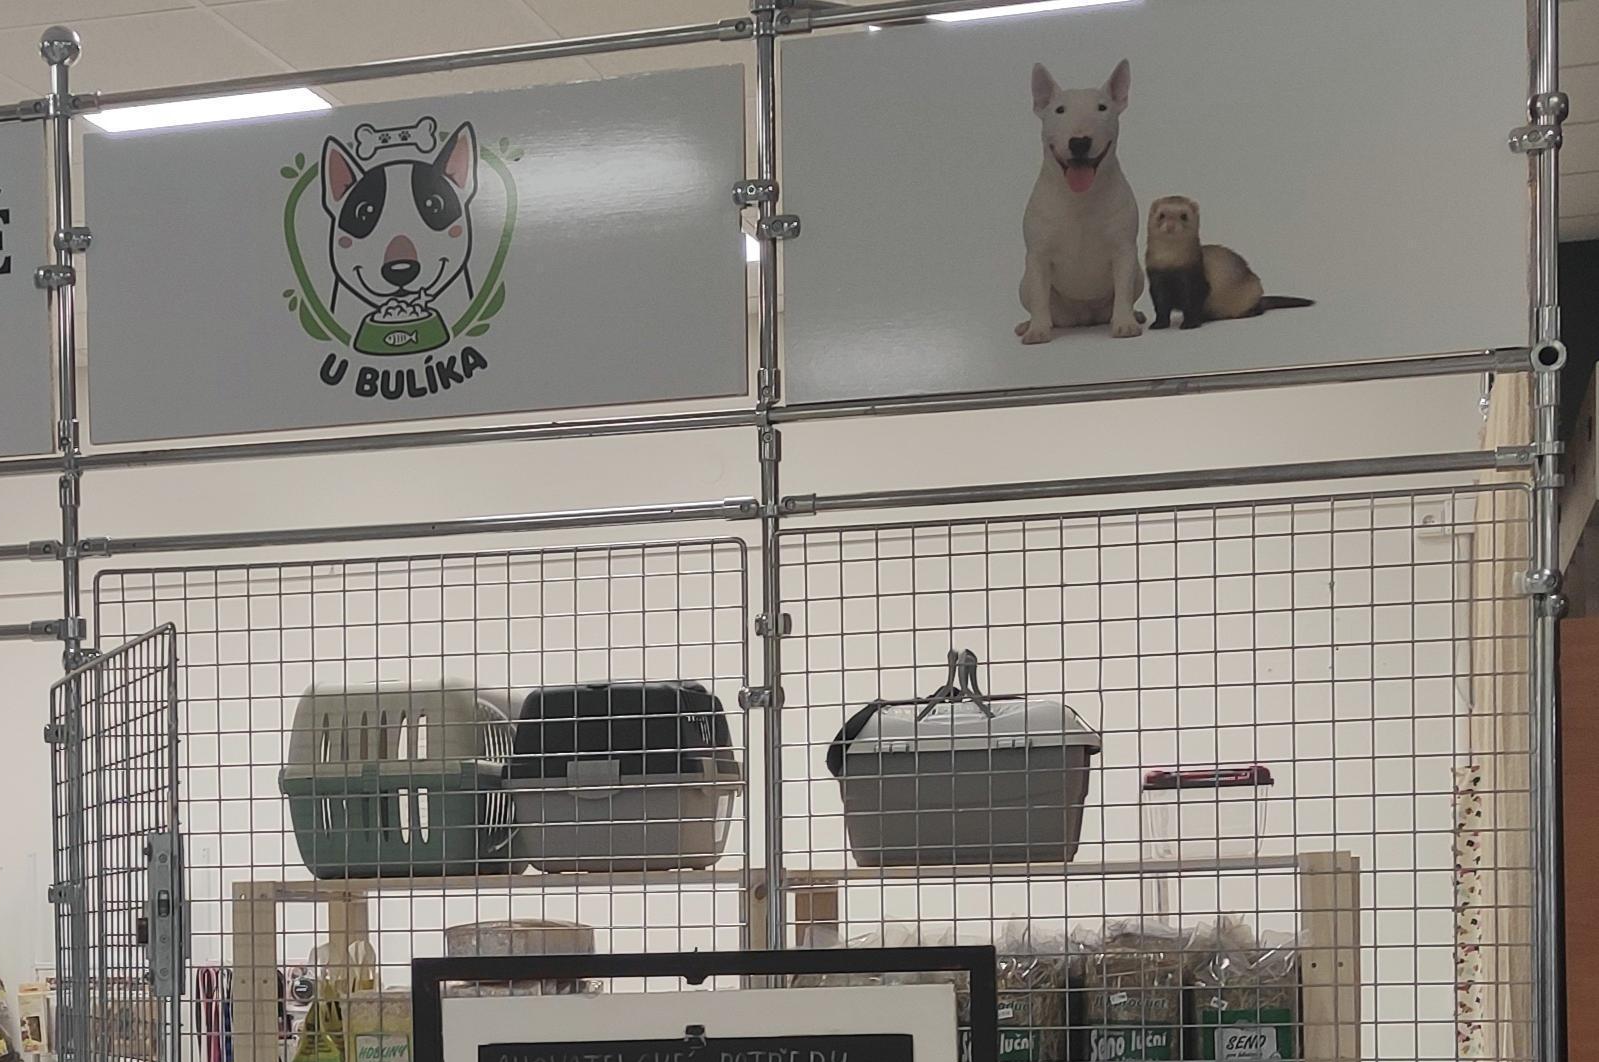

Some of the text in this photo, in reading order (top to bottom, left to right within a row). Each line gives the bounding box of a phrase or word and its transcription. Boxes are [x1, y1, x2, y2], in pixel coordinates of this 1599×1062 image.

[319, 346, 488, 400] U BULÍKA
[1226, 1035, 1267, 1051] SENO
